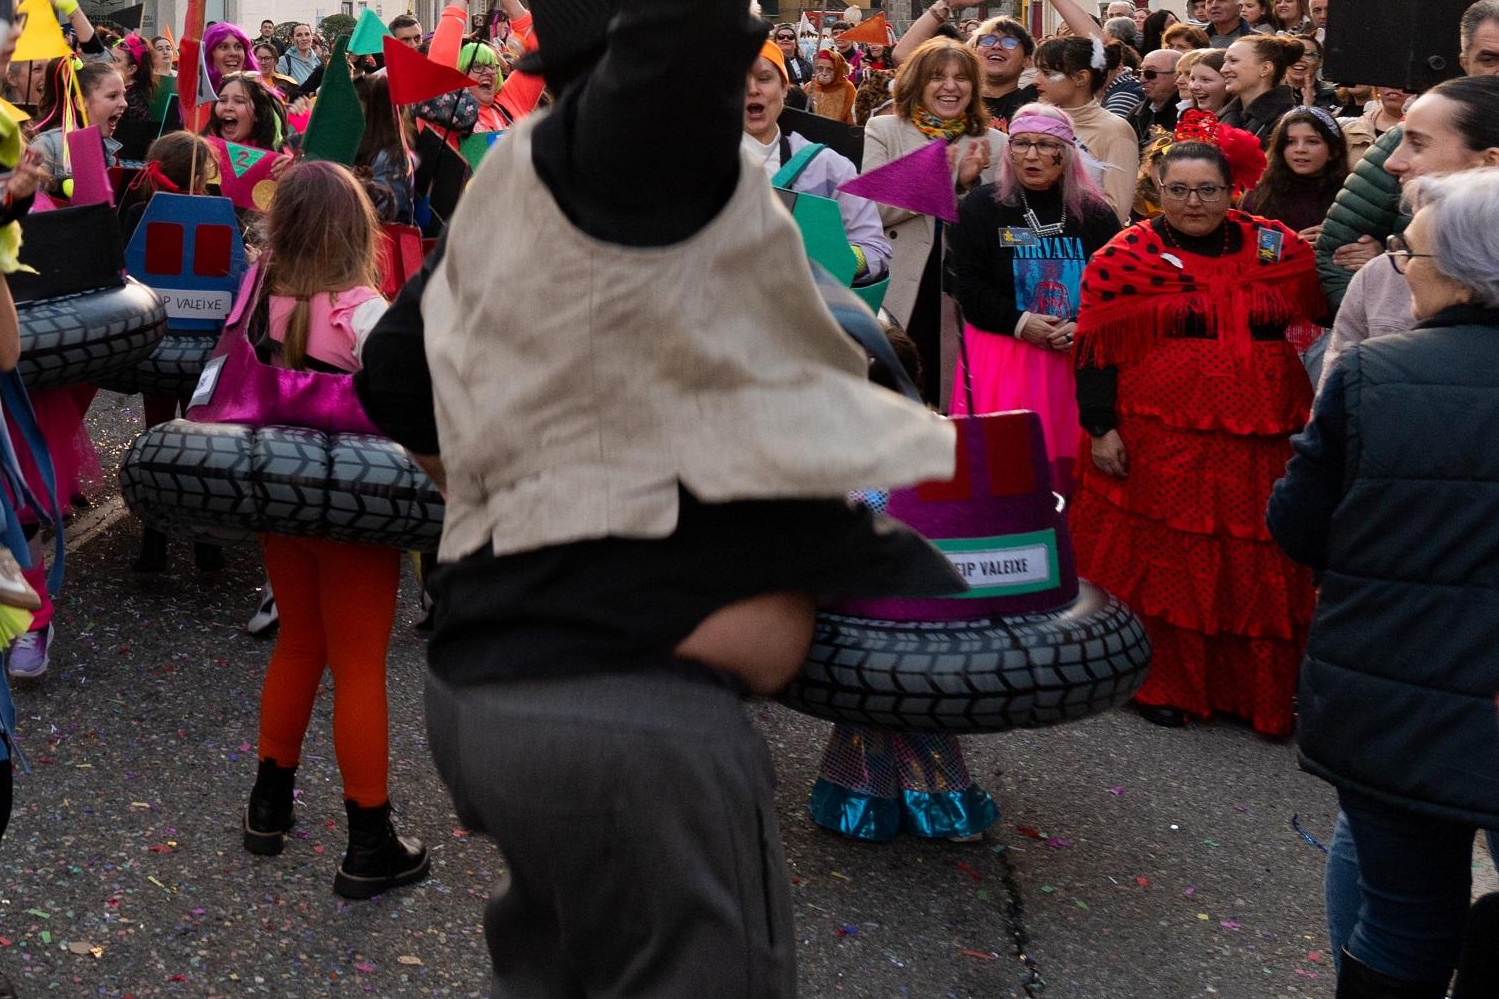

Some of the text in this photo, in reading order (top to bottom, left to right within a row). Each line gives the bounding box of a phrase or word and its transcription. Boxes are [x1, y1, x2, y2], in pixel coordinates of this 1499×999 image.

[237, 151, 250, 169] 2
[1013, 237, 1085, 259] NIRVANA
[980, 558, 1028, 576] VALEIXE
